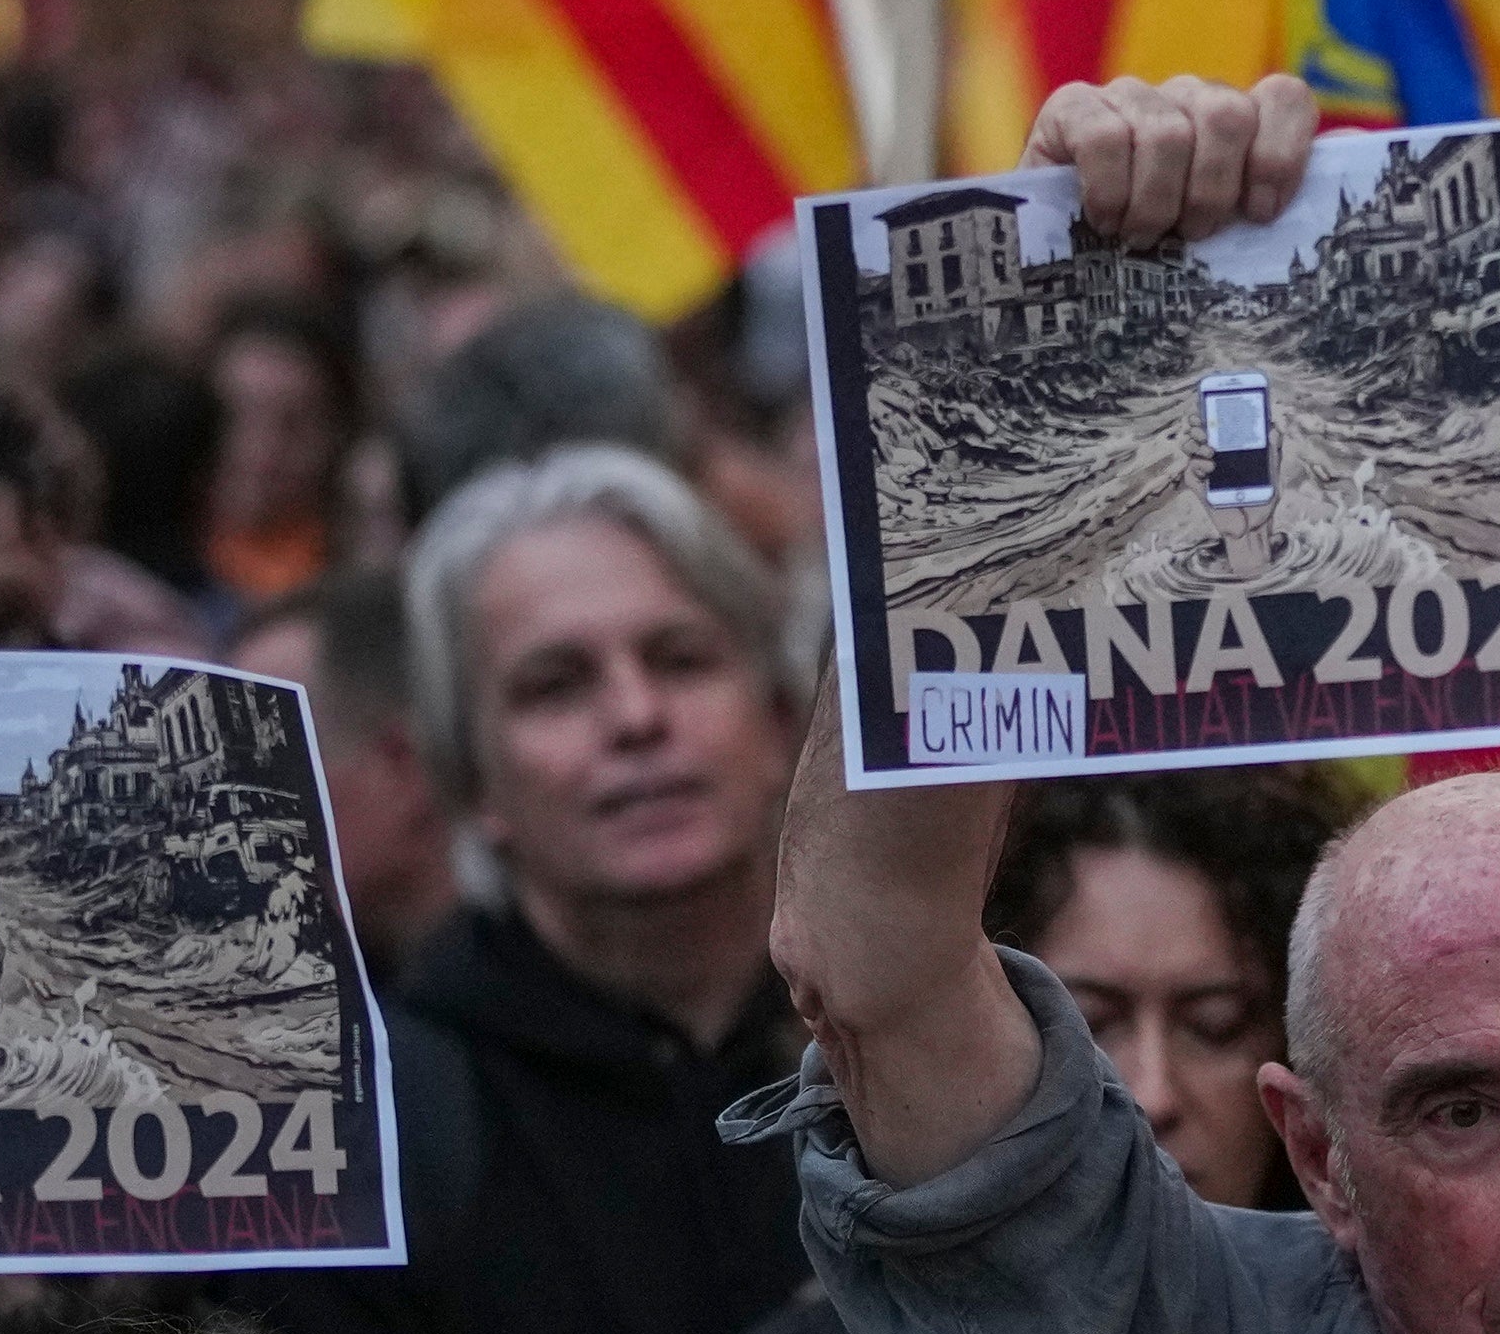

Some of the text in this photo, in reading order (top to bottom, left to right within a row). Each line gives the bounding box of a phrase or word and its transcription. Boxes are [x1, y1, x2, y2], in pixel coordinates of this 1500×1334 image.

[887, 587, 1284, 713] DANA
[918, 681, 1076, 759] CRIMIN
[32, 1091, 348, 1203] 2024
